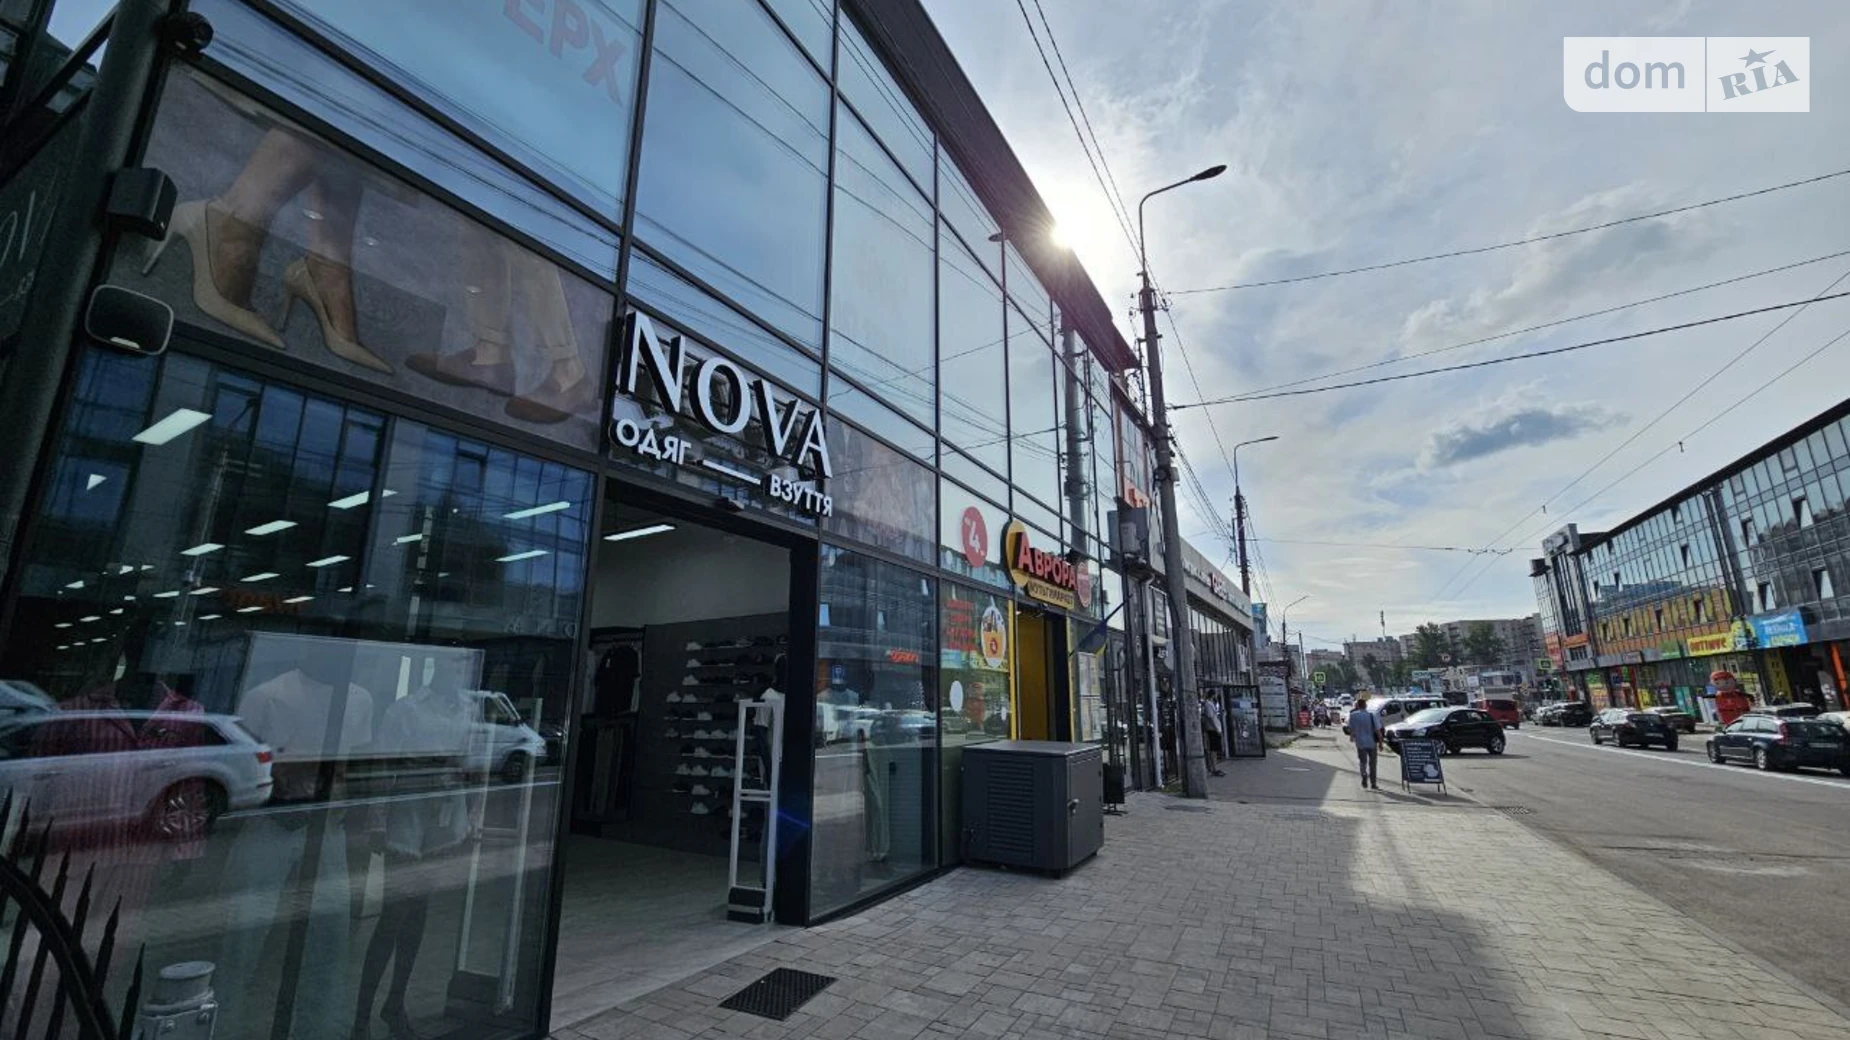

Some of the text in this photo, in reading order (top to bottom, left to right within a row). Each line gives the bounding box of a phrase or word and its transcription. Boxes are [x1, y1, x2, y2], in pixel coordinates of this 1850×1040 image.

[622, 311, 833, 478] NOVA
[614, 419, 833, 517] ОДЯГ ВЗУТТЯ
